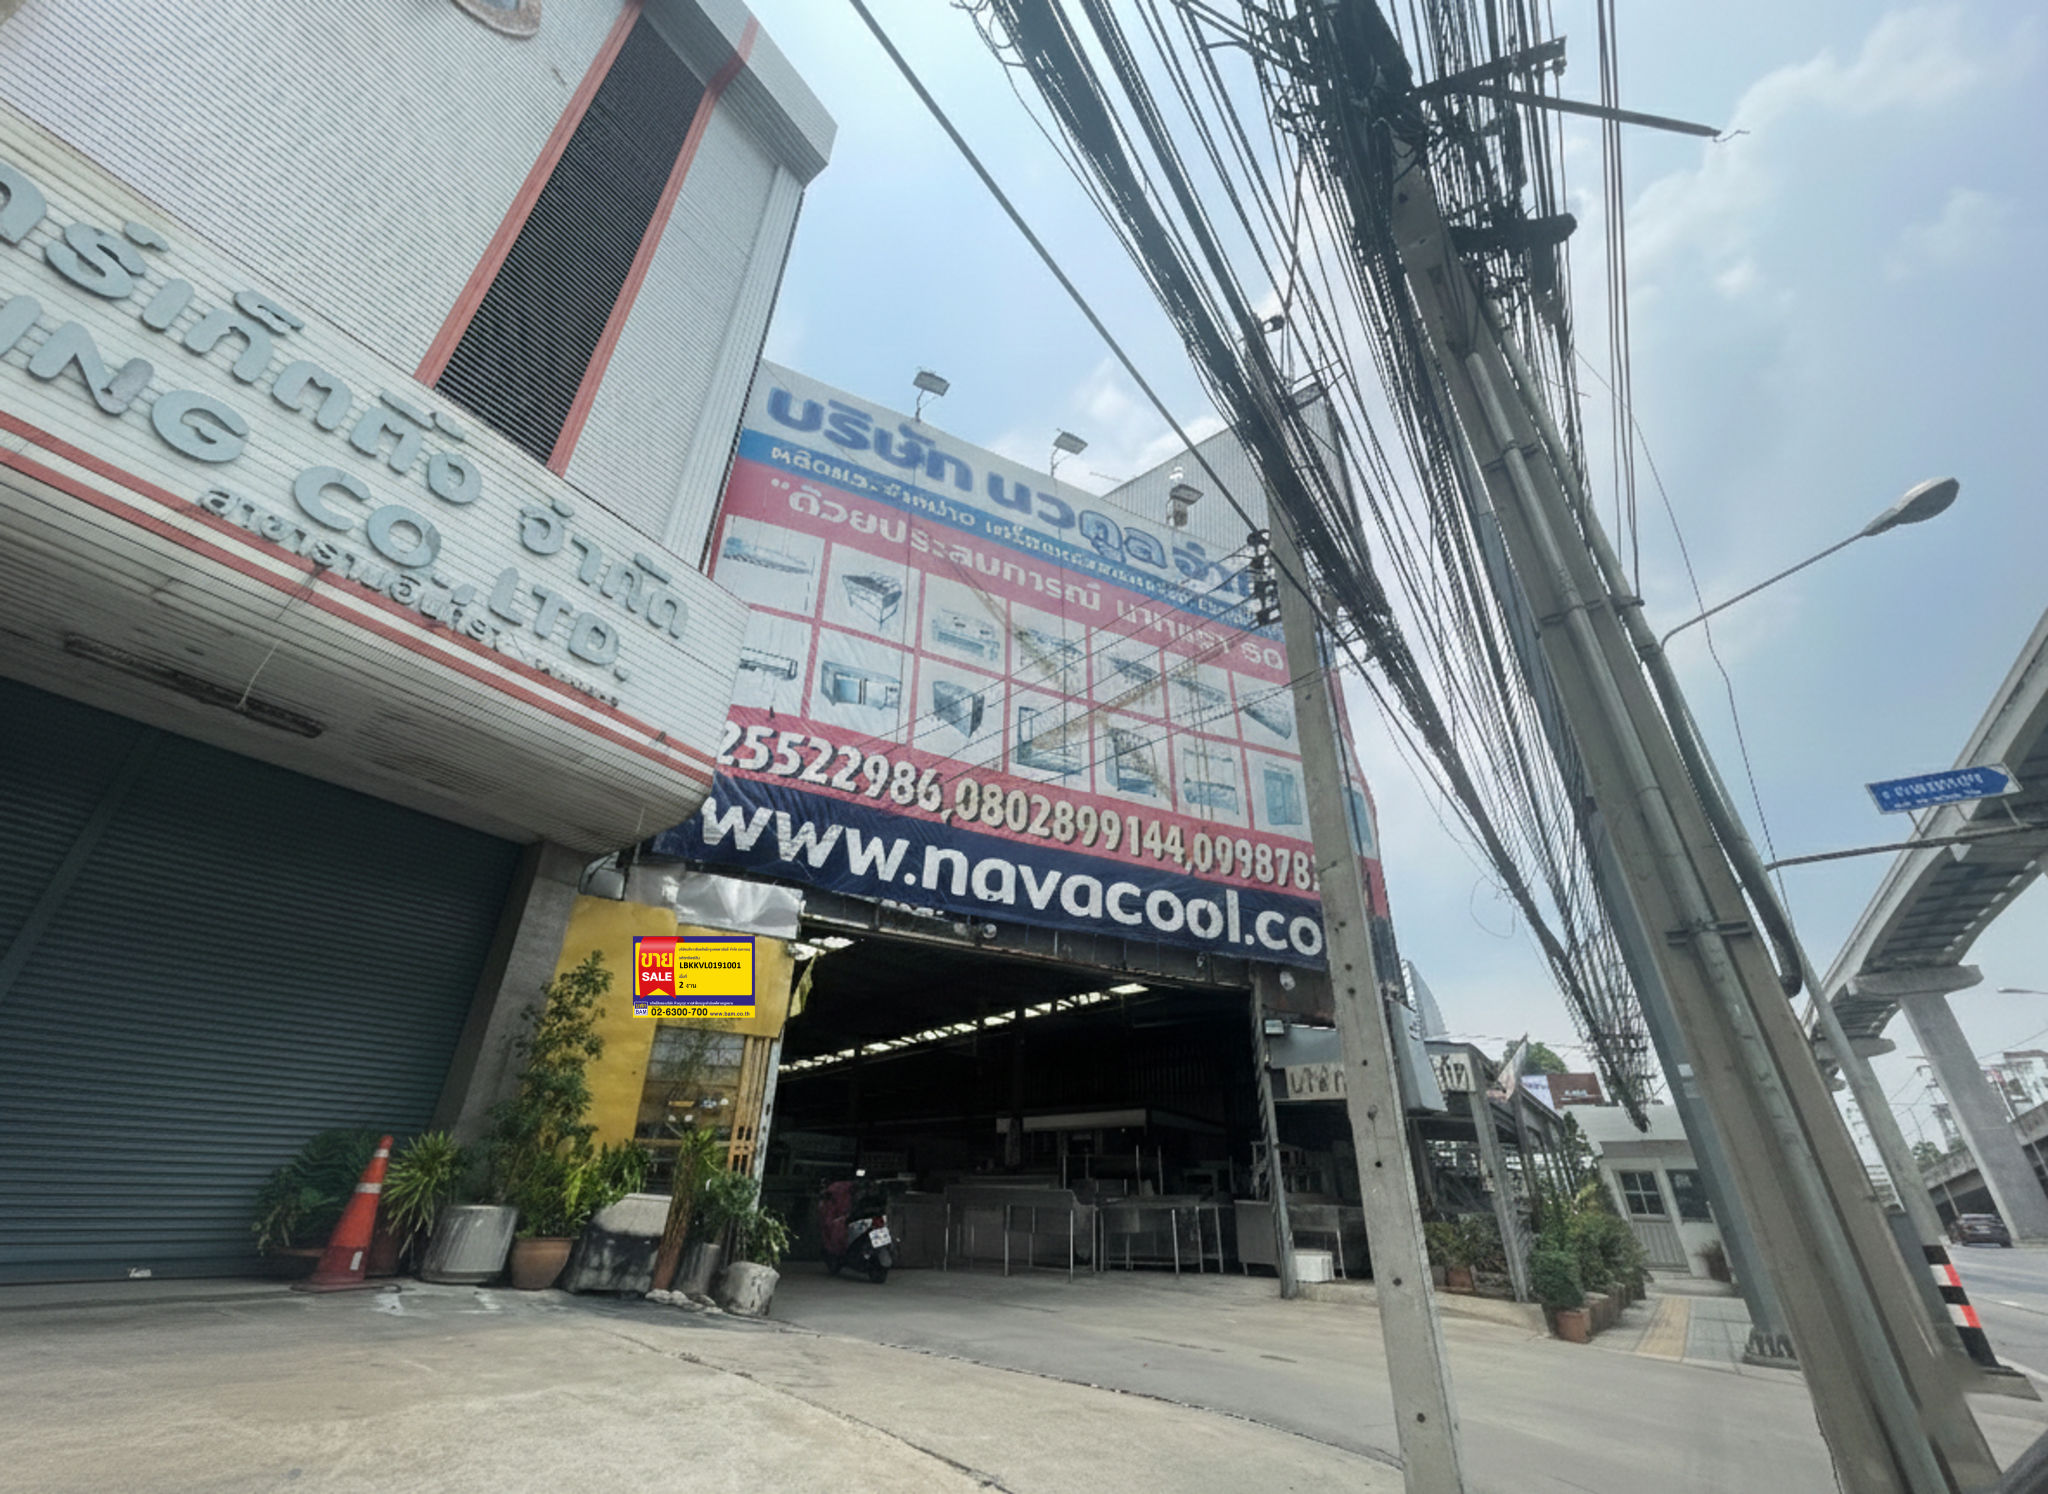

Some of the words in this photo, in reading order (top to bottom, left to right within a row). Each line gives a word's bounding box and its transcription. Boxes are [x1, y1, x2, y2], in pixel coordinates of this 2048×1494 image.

[766, 386, 974, 494] บริษัท
[487, 566, 630, 682] LTD.
[518, 498, 690, 641] จำกัด
